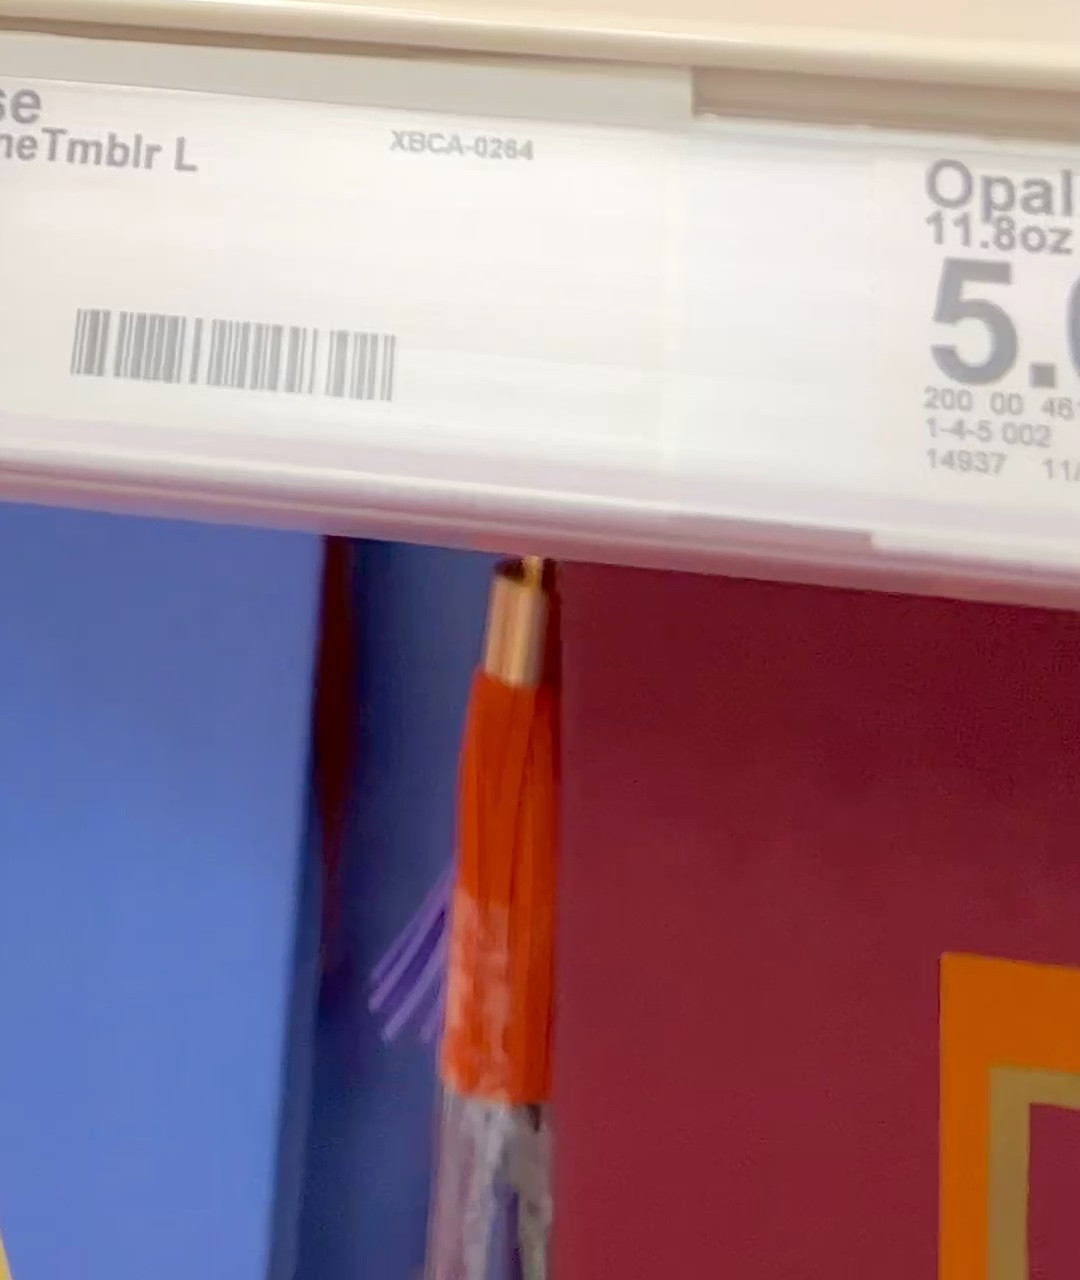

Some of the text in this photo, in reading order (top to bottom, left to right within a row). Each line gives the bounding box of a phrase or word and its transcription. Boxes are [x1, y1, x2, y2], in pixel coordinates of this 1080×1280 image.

[173, 136, 199, 172] L
[390, 130, 536, 161] XBCA-0264
[925, 158, 1074, 225] Opal
[926, 211, 1074, 255] 11.8oz
[930, 256, 1080, 387] 5.
[923, 385, 975, 413] 200
[989, 391, 1025, 416] 00
[926, 416, 1053, 448] 1-4-5 002
[926, 447, 1008, 475] 14937
